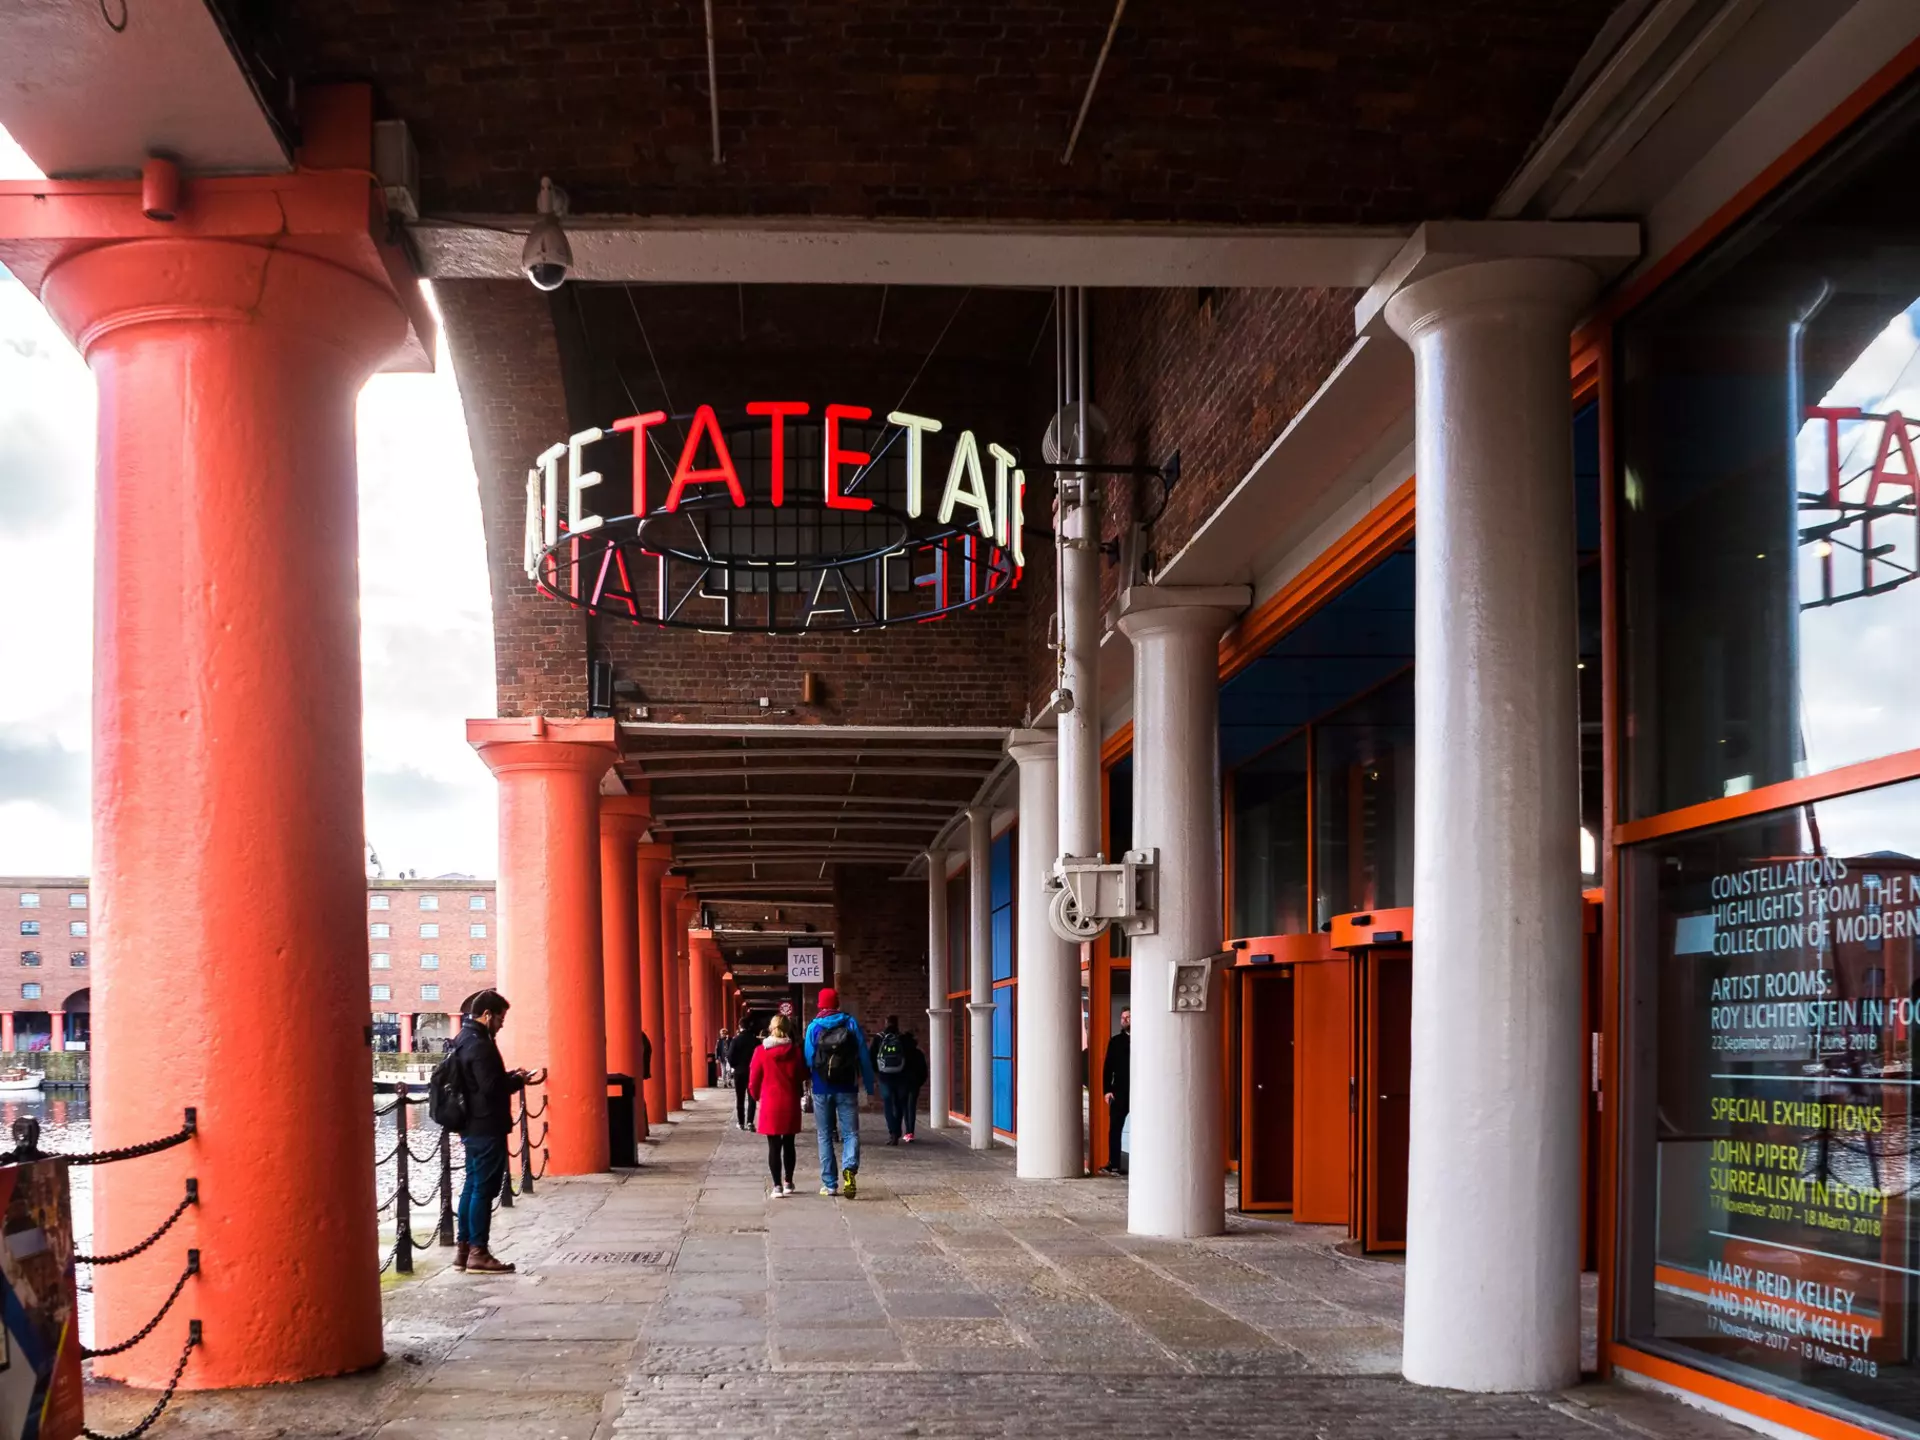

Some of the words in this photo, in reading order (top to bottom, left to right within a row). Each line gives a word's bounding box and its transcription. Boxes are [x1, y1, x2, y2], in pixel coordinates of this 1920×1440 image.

[613, 401, 873, 518] TATE
[1711, 858, 1848, 899] CONSTELLATIONS
[1711, 892, 1804, 926] HIGHLIGHTS
[1808, 883, 1860, 915] FROM
[1864, 876, 1903, 906] THE
[1711, 923, 1803, 956] COLLECTION
[1807, 919, 1831, 947] OF
[1836, 910, 1920, 944] MODERN
[792, 965, 820, 977] CAFÉ
[793, 954, 818, 965] TATE
[1711, 974, 1760, 1001] ARTIST
[1765, 969, 1832, 998] ROOMS:
[1711, 1006, 1741, 1030] ROY
[1744, 1000, 1857, 1029] LICHTENSTEIN
[1862, 999, 1883, 1026] IN
[1724, 1035, 1772, 1053] September
[1772, 1035, 1797, 1050] 2017
[1822, 1035, 1847, 1050] June
[1850, 1034, 1878, 1050] 2018
[1711, 1097, 1768, 1124] SPECIAL
[1773, 1101, 1882, 1133] EXHIBITIONS
[1710, 1140, 1751, 1165] JOHN
[1755, 1142, 1808, 1172] PIPER/
[1710, 1168, 1806, 1203] SURREALISM
[1811, 1180, 1830, 1207] IN
[1835, 1183, 1891, 1215] EGYPT
[1722, 1197, 1767, 1216] November
[1768, 1204, 1793, 1221] 2017
[1804, 1209, 1816, 1225] 18
[1818, 1212, 1851, 1232] March
[1853, 1217, 1881, 1237] 2018
[1708, 1259, 1752, 1290] MARY
[1756, 1271, 1790, 1300] REID
[1796, 1279, 1856, 1315] KELLEY
[1707, 1288, 1739, 1316] AND
[1744, 1297, 1807, 1336] PATRICK
[1811, 1314, 1872, 1354] KELLEY
[1707, 1315, 1718, 1330] 17
[1719, 1320, 1764, 1344] November
[1765, 1331, 1790, 1351] 2017
[1800, 1342, 1813, 1360] 18
[1815, 1346, 1847, 1368] March
[1849, 1356, 1878, 1378] 2018
